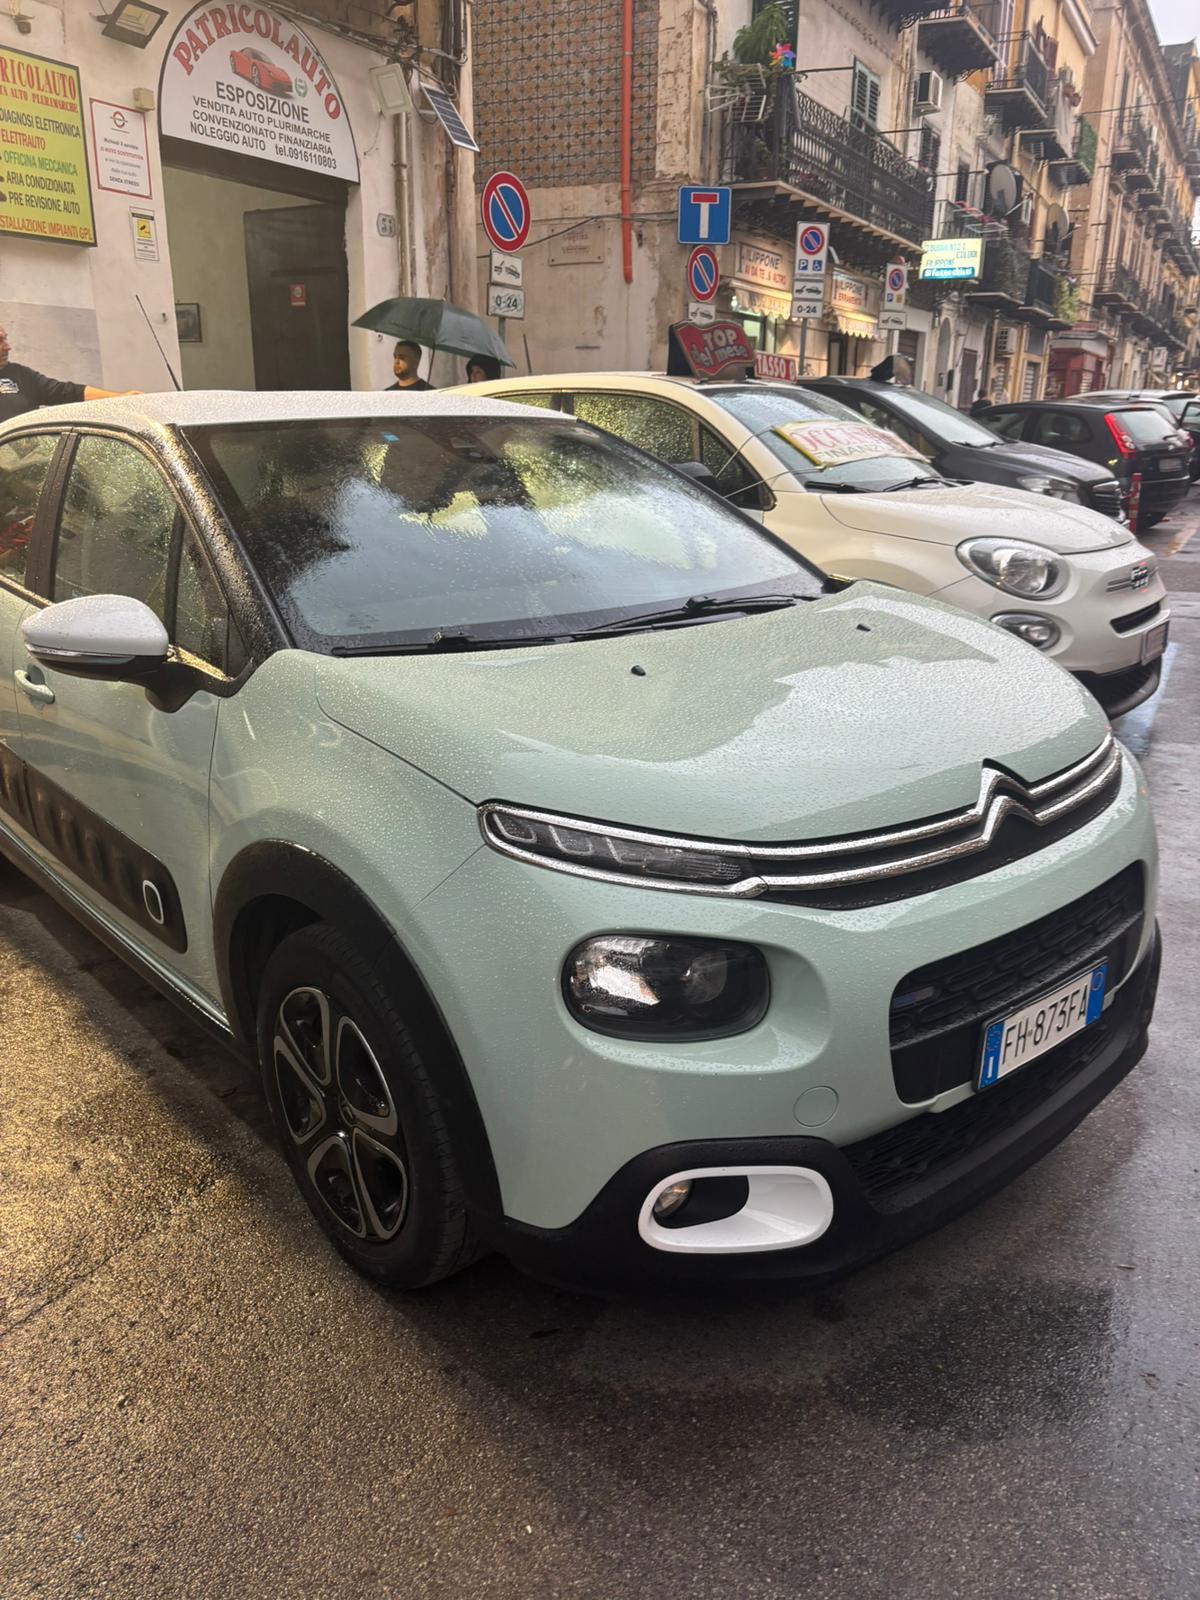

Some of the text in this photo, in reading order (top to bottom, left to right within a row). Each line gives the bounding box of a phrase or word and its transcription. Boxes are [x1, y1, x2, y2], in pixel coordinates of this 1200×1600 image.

[173, 3, 341, 120] PATRICOLAUTO
[216, 81, 310, 124] ESPOSIZIONE
[35, 116, 81, 138] ELETTRONICA
[193, 96, 331, 143] VENDITA AUTO PLURIMARCHE
[0, 128, 46, 151] ELETTRAUTO
[192, 110, 333, 156] CONVENZIONATO FINANZIARIA
[190, 121, 337, 170] NOLEGGIO AUTO tel.0916110803
[4, 150, 78, 176] OFFICINA MECCANICA
[6, 171, 76, 195] ARIA CONDIZIONATA
[8, 191, 80, 215] PRE REVISIONE AUTO
[48, 222, 78, 238] IMPIANTI
[796, 305, 817, 314] 0-24
[701, 329, 738, 351] TOP
[757, 354, 787, 379] TASSO
